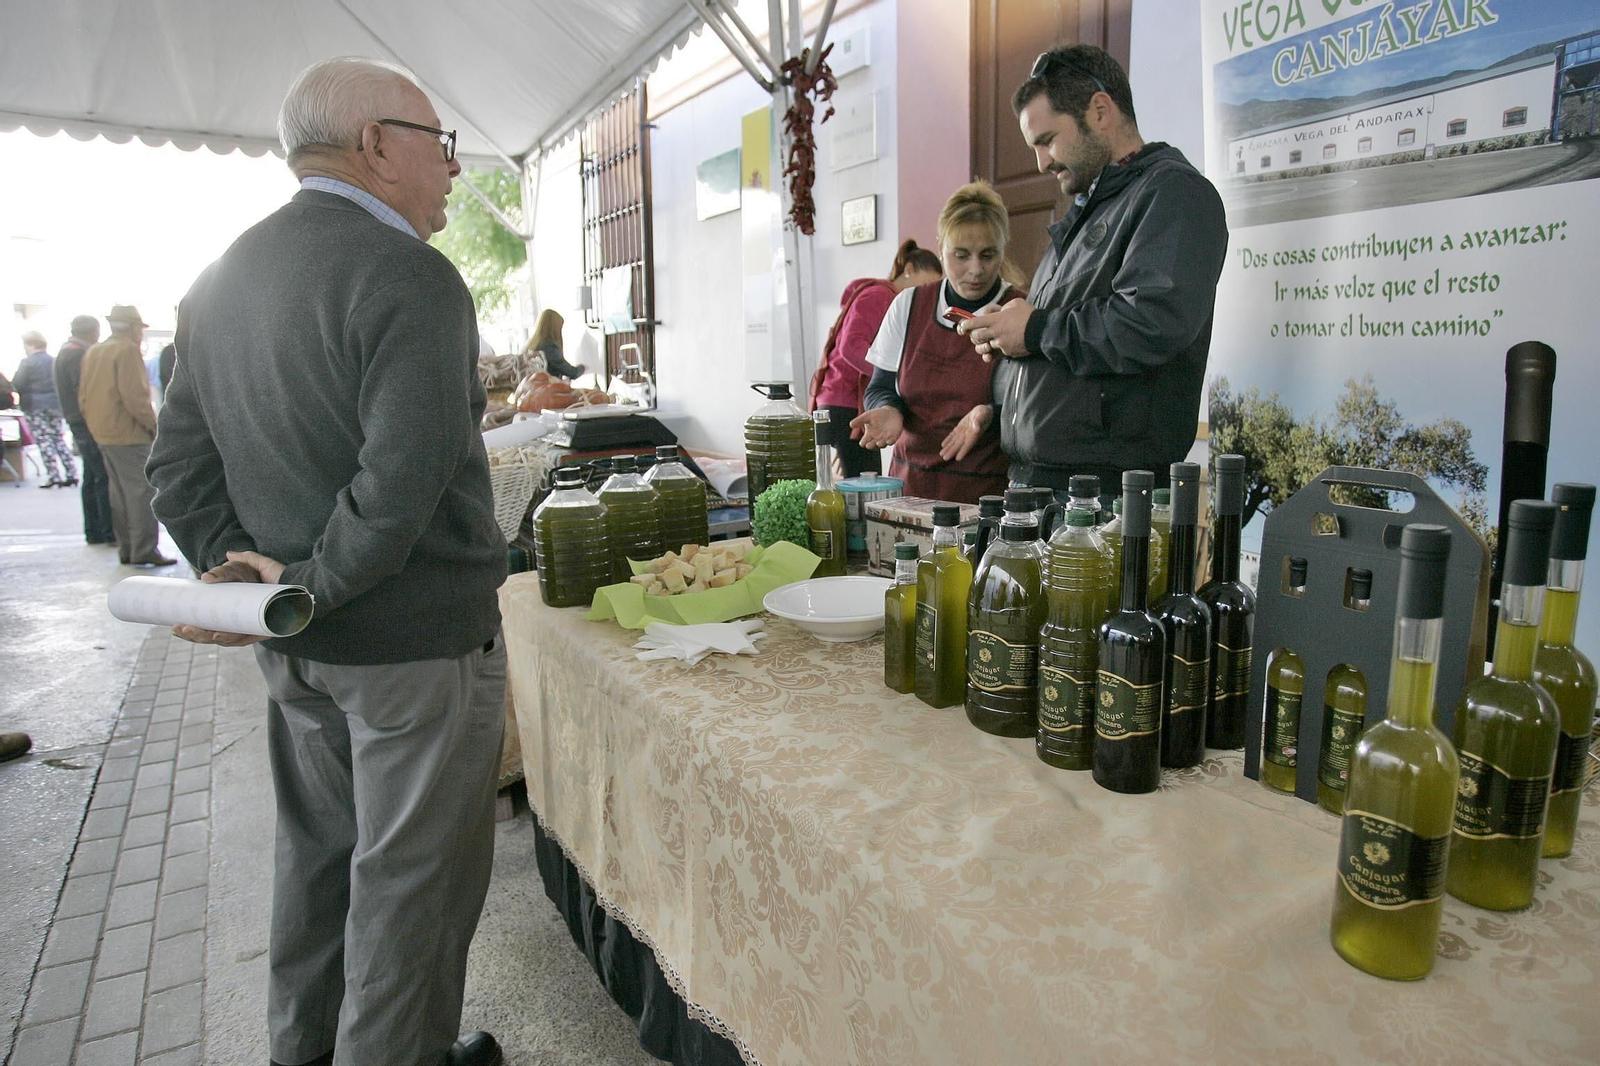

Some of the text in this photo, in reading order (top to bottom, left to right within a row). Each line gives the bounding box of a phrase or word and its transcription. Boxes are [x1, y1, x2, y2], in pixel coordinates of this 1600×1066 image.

[1223, 0, 1306, 52] VEGA
[1272, 0, 1498, 86] CANJÁYAR
[1294, 130, 1324, 143] VEGA
[1330, 124, 1348, 136] DEL
[1355, 107, 1424, 130] ANDARAX
[1273, 248, 1316, 266] cosas
[1322, 232, 1433, 261] contribuyen
[1440, 234, 1454, 251] a
[1460, 220, 1567, 250] avanzar:
[1275, 268, 1500, 303] Ir más veloz que el resto
[1270, 323, 1279, 338] o
[1285, 320, 1335, 337] tomar
[1340, 313, 1353, 337] el
[1359, 313, 1404, 337] buen
[1349, 855, 1406, 885] Canjayar
